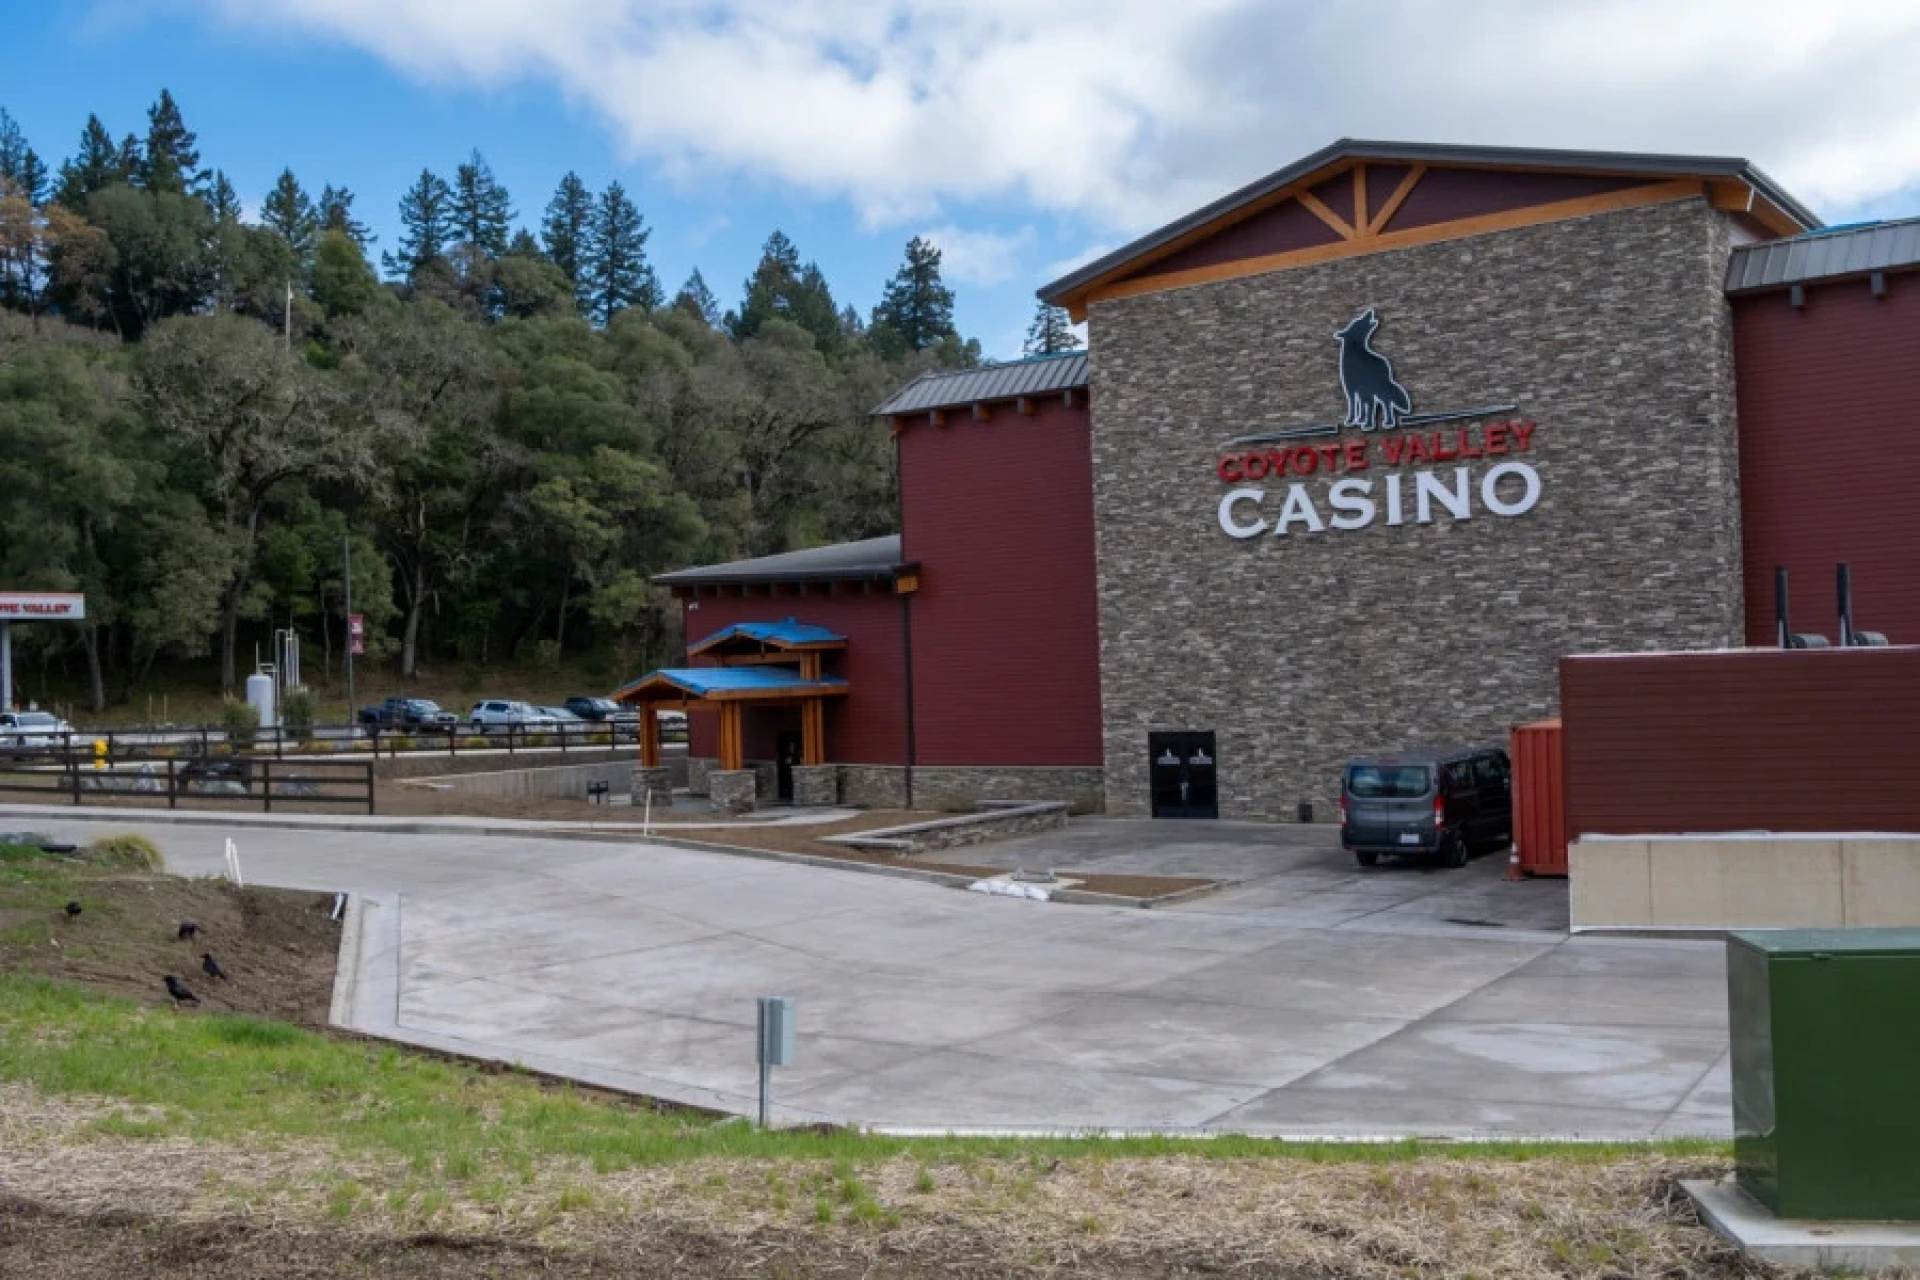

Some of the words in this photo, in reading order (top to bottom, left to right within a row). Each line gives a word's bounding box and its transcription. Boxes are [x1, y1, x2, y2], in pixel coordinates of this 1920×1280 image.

[1216, 439, 1370, 483] COYOTE
[1380, 419, 1537, 466] VALLEY
[1217, 461, 1542, 539] CASINO
